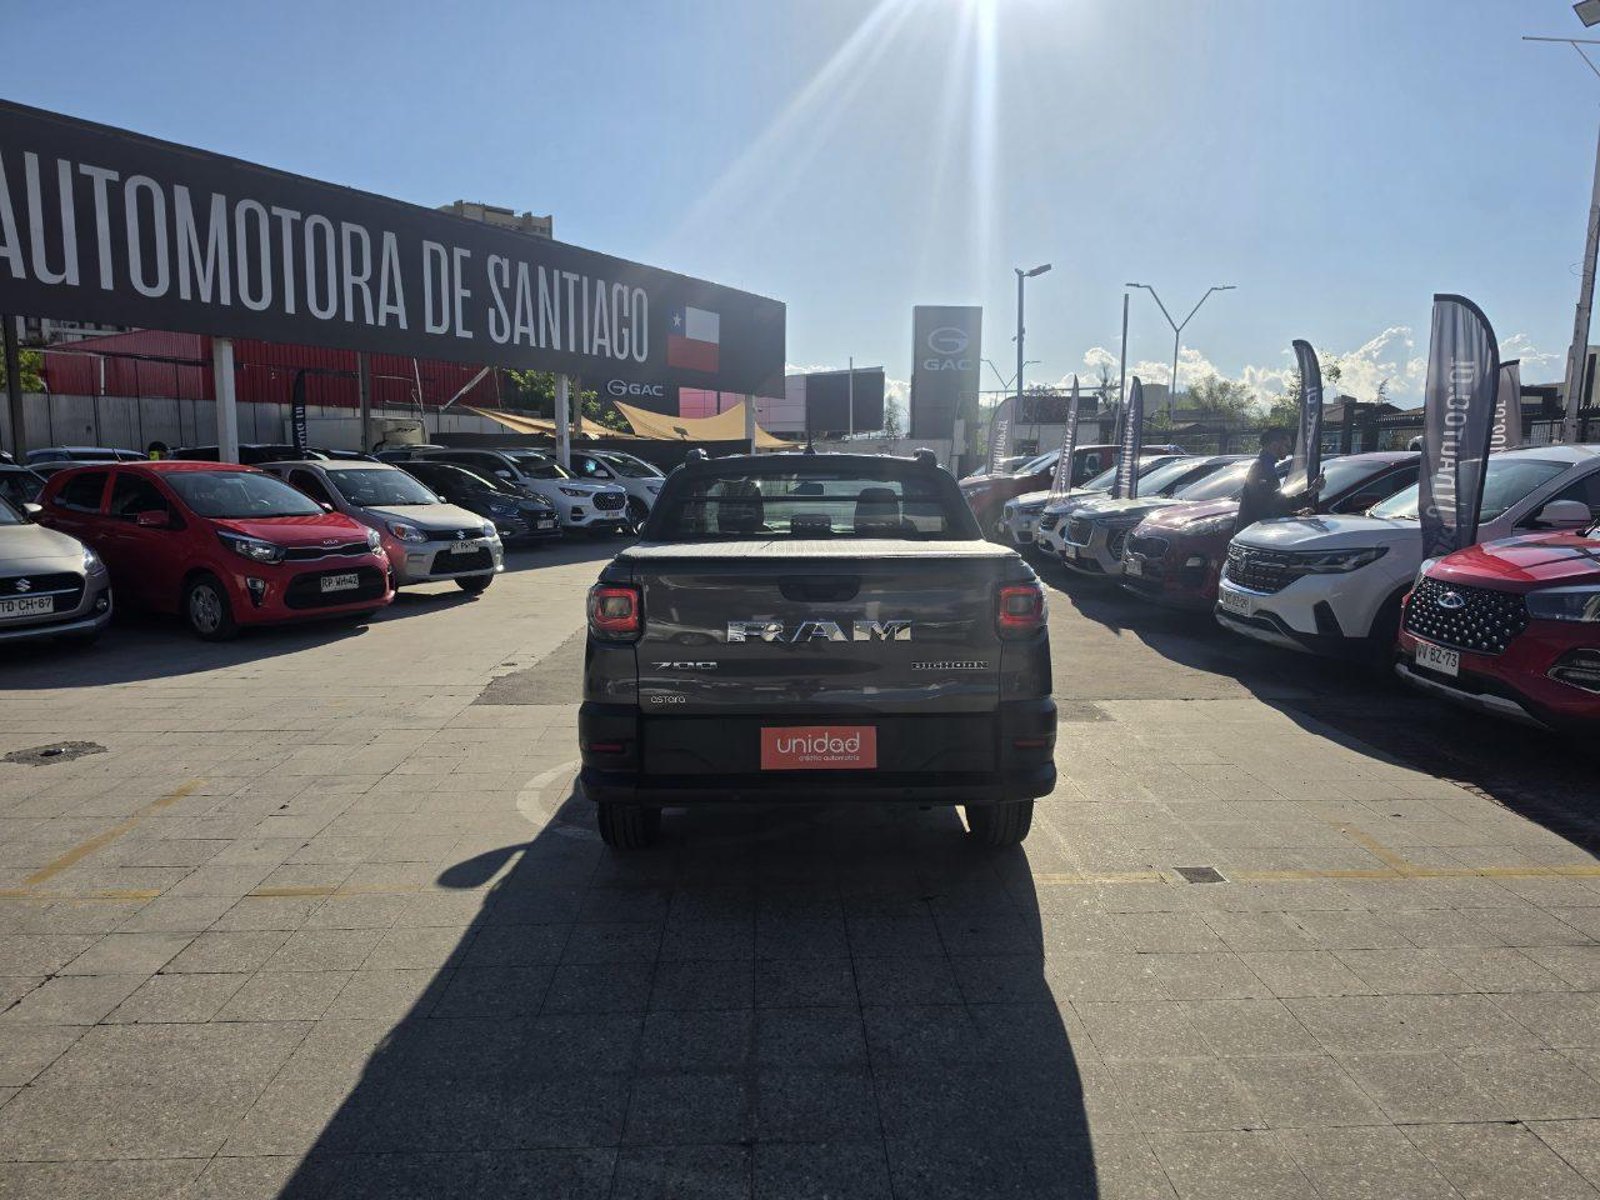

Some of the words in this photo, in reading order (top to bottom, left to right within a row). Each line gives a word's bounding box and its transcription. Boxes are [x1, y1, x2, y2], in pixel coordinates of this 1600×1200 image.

[0, 150, 408, 330] AUTOMOTORA
[422, 240, 473, 339] DE
[487, 254, 649, 363] SANTIAGO
[923, 359, 972, 371] GAC
[629, 383, 664, 396] GAC
[727, 619, 913, 643] RAM
[651, 661, 718, 671] 700
[777, 732, 860, 753] unidad
